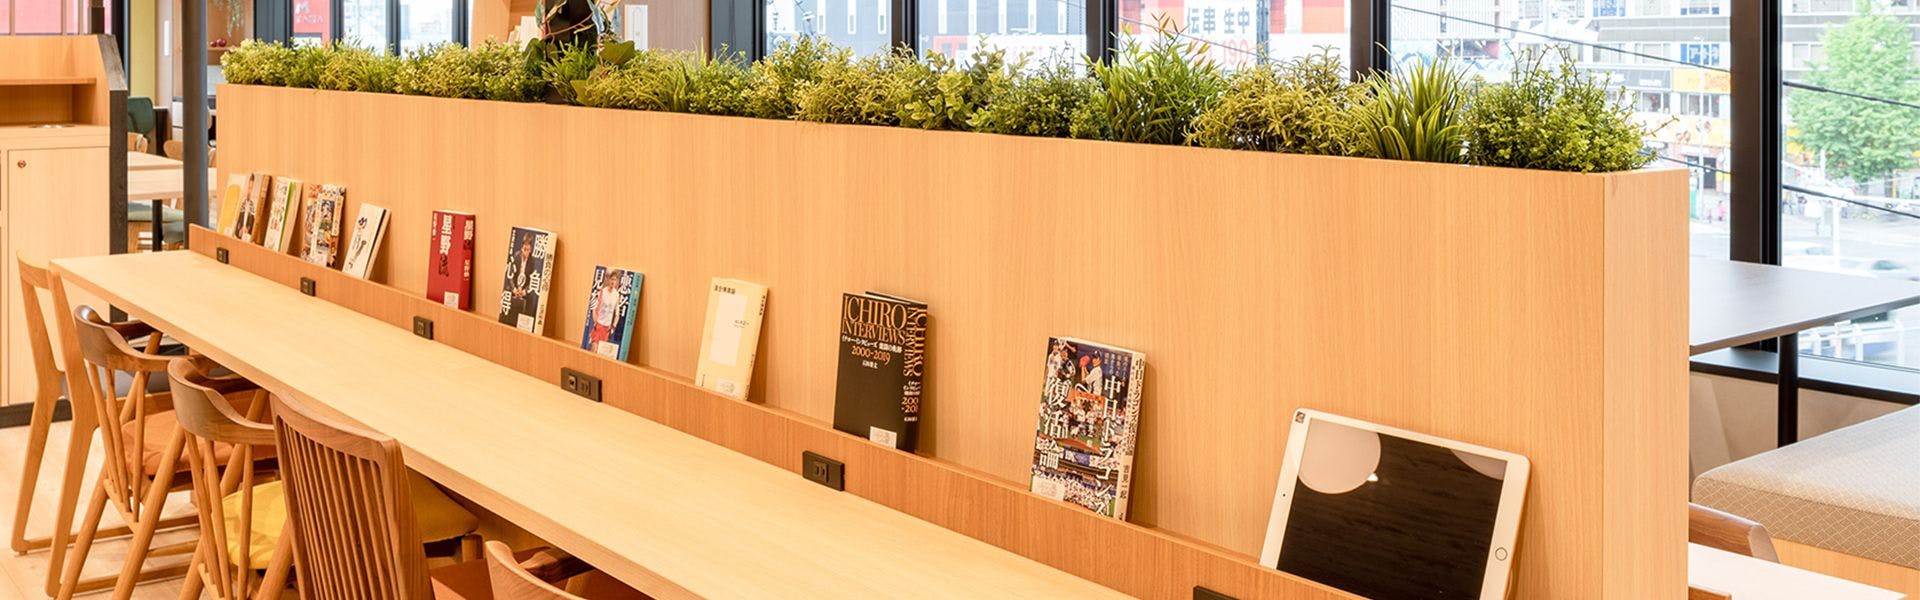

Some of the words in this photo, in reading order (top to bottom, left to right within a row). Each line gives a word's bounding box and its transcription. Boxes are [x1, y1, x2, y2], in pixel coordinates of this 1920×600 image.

[438, 214, 453, 277] 星野流
[527, 234, 549, 297] 勝負
[841, 318, 906, 346] INTERVIEWS
[844, 295, 908, 331] ICHIRO
[903, 306, 916, 377] INTERVIEWS
[913, 307, 928, 377] ICHIRO
[851, 345, 891, 366] 2000-2019
[1039, 377, 1072, 470] 復活論
